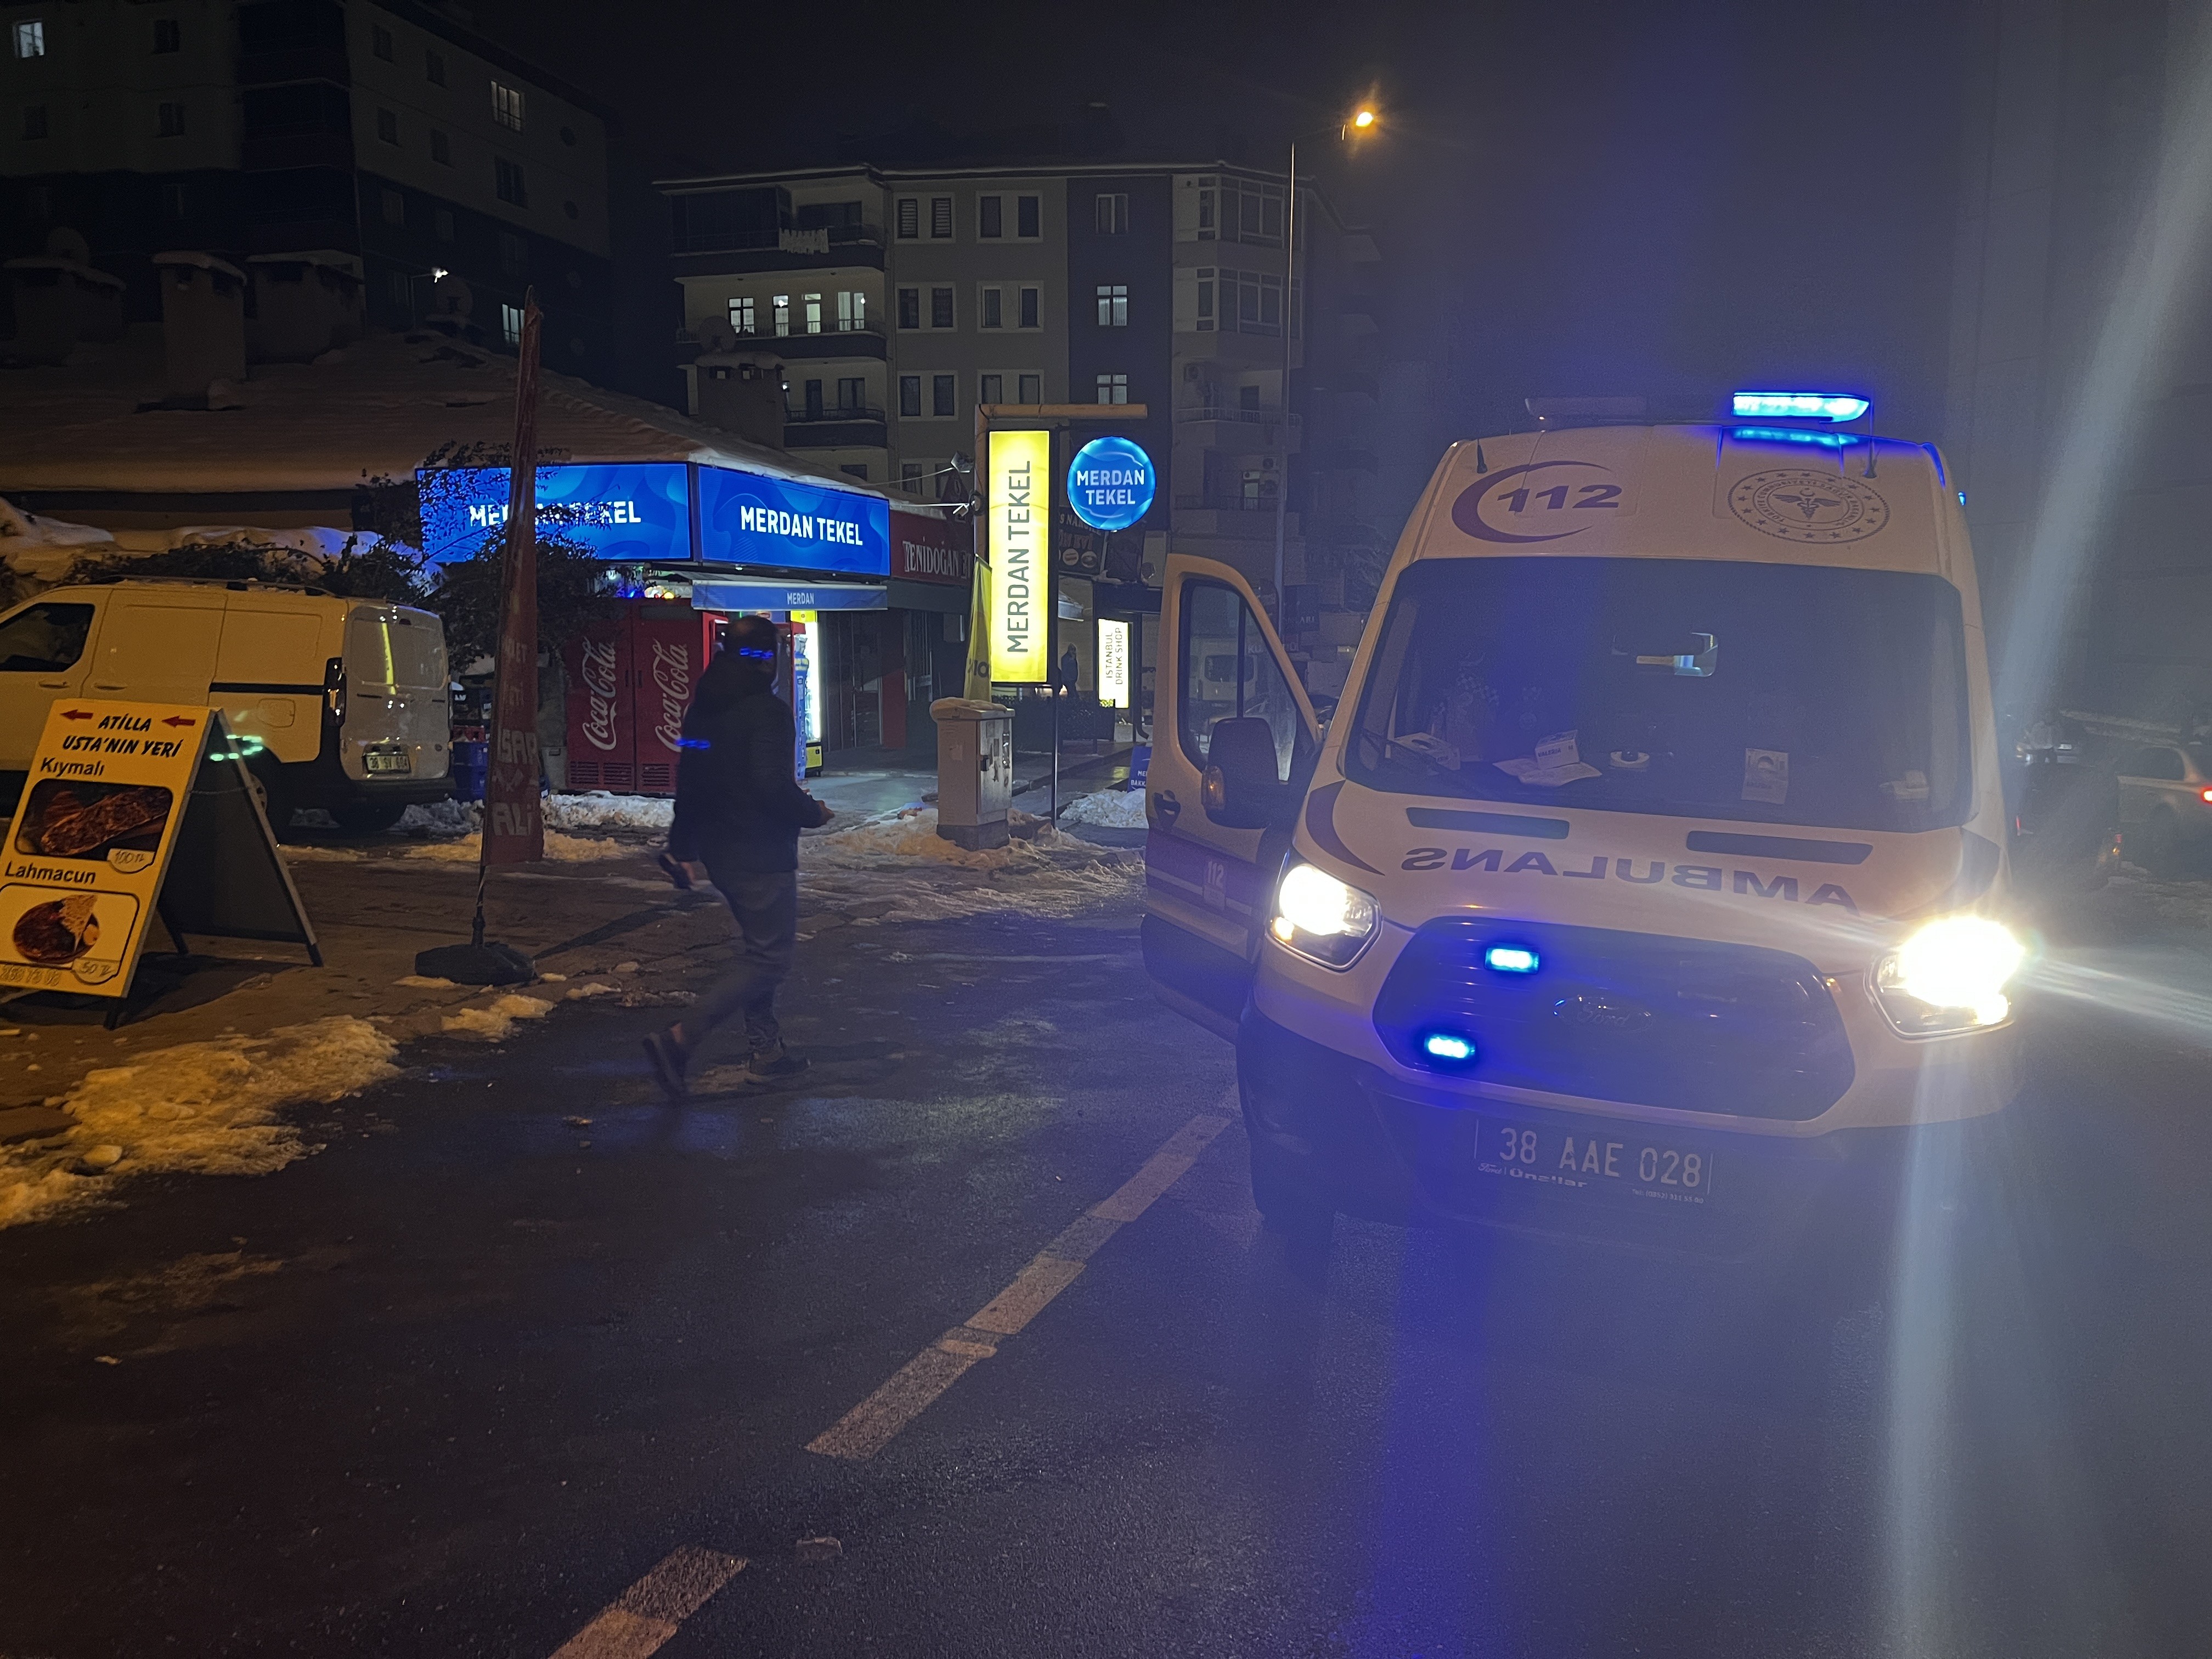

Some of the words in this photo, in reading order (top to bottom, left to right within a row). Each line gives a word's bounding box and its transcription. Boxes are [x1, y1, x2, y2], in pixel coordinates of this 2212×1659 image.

[1077, 470, 1144, 486] MERDAN
[1008, 460, 1030, 541] TEKEL
[1086, 489, 1136, 505] TEKEL
[1497, 484, 1622, 512] 112
[741, 505, 813, 539] MERDAN
[816, 517, 863, 546] TEKEL
[787, 592, 814, 605] MERDAN
[1007, 549, 1029, 653] MERDAN
[582, 636, 617, 750] Coca-Cola
[98, 713, 152, 732] ATİLLA
[63, 735, 139, 754] USTA'NIN
[141, 738, 184, 758] YERİ
[40, 757, 104, 777] Kıymalı
[4, 860, 96, 884] Lahmacun
[1207, 861, 1224, 888] 112
[1478, 1162, 1503, 1175] Ford
[1499, 1127, 1537, 1164] 38
[1559, 1137, 1623, 1177] AAE
[1639, 1147, 1701, 1187] 028
